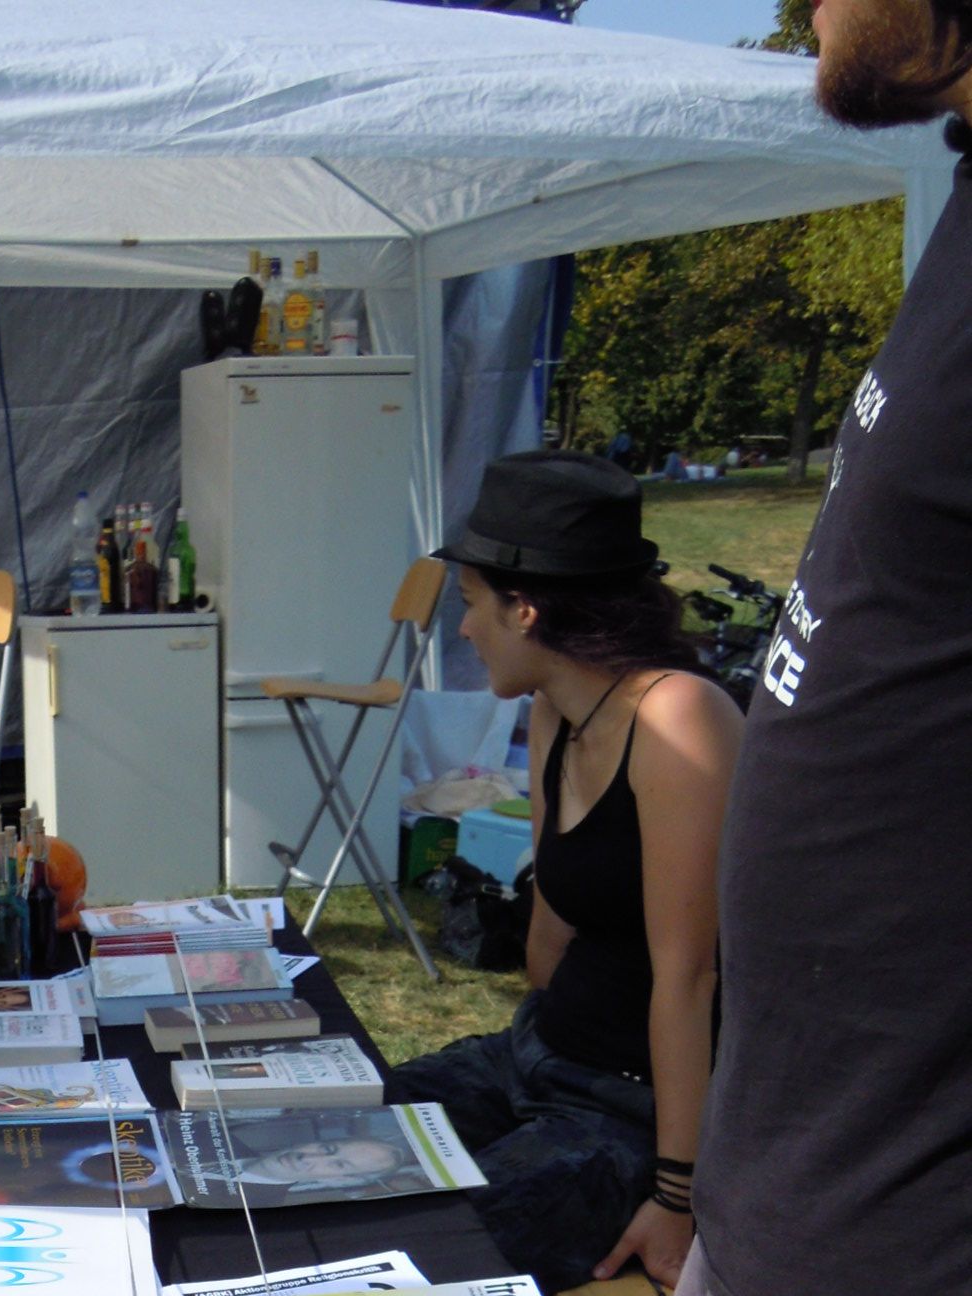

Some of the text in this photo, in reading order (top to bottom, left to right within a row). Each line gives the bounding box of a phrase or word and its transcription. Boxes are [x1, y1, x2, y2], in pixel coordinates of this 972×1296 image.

[179, 1118, 195, 1145] Heinz
[234, 1278, 307, 1296] Aktionsgruppe
[307, 1265, 382, 1284] Religionskritik
